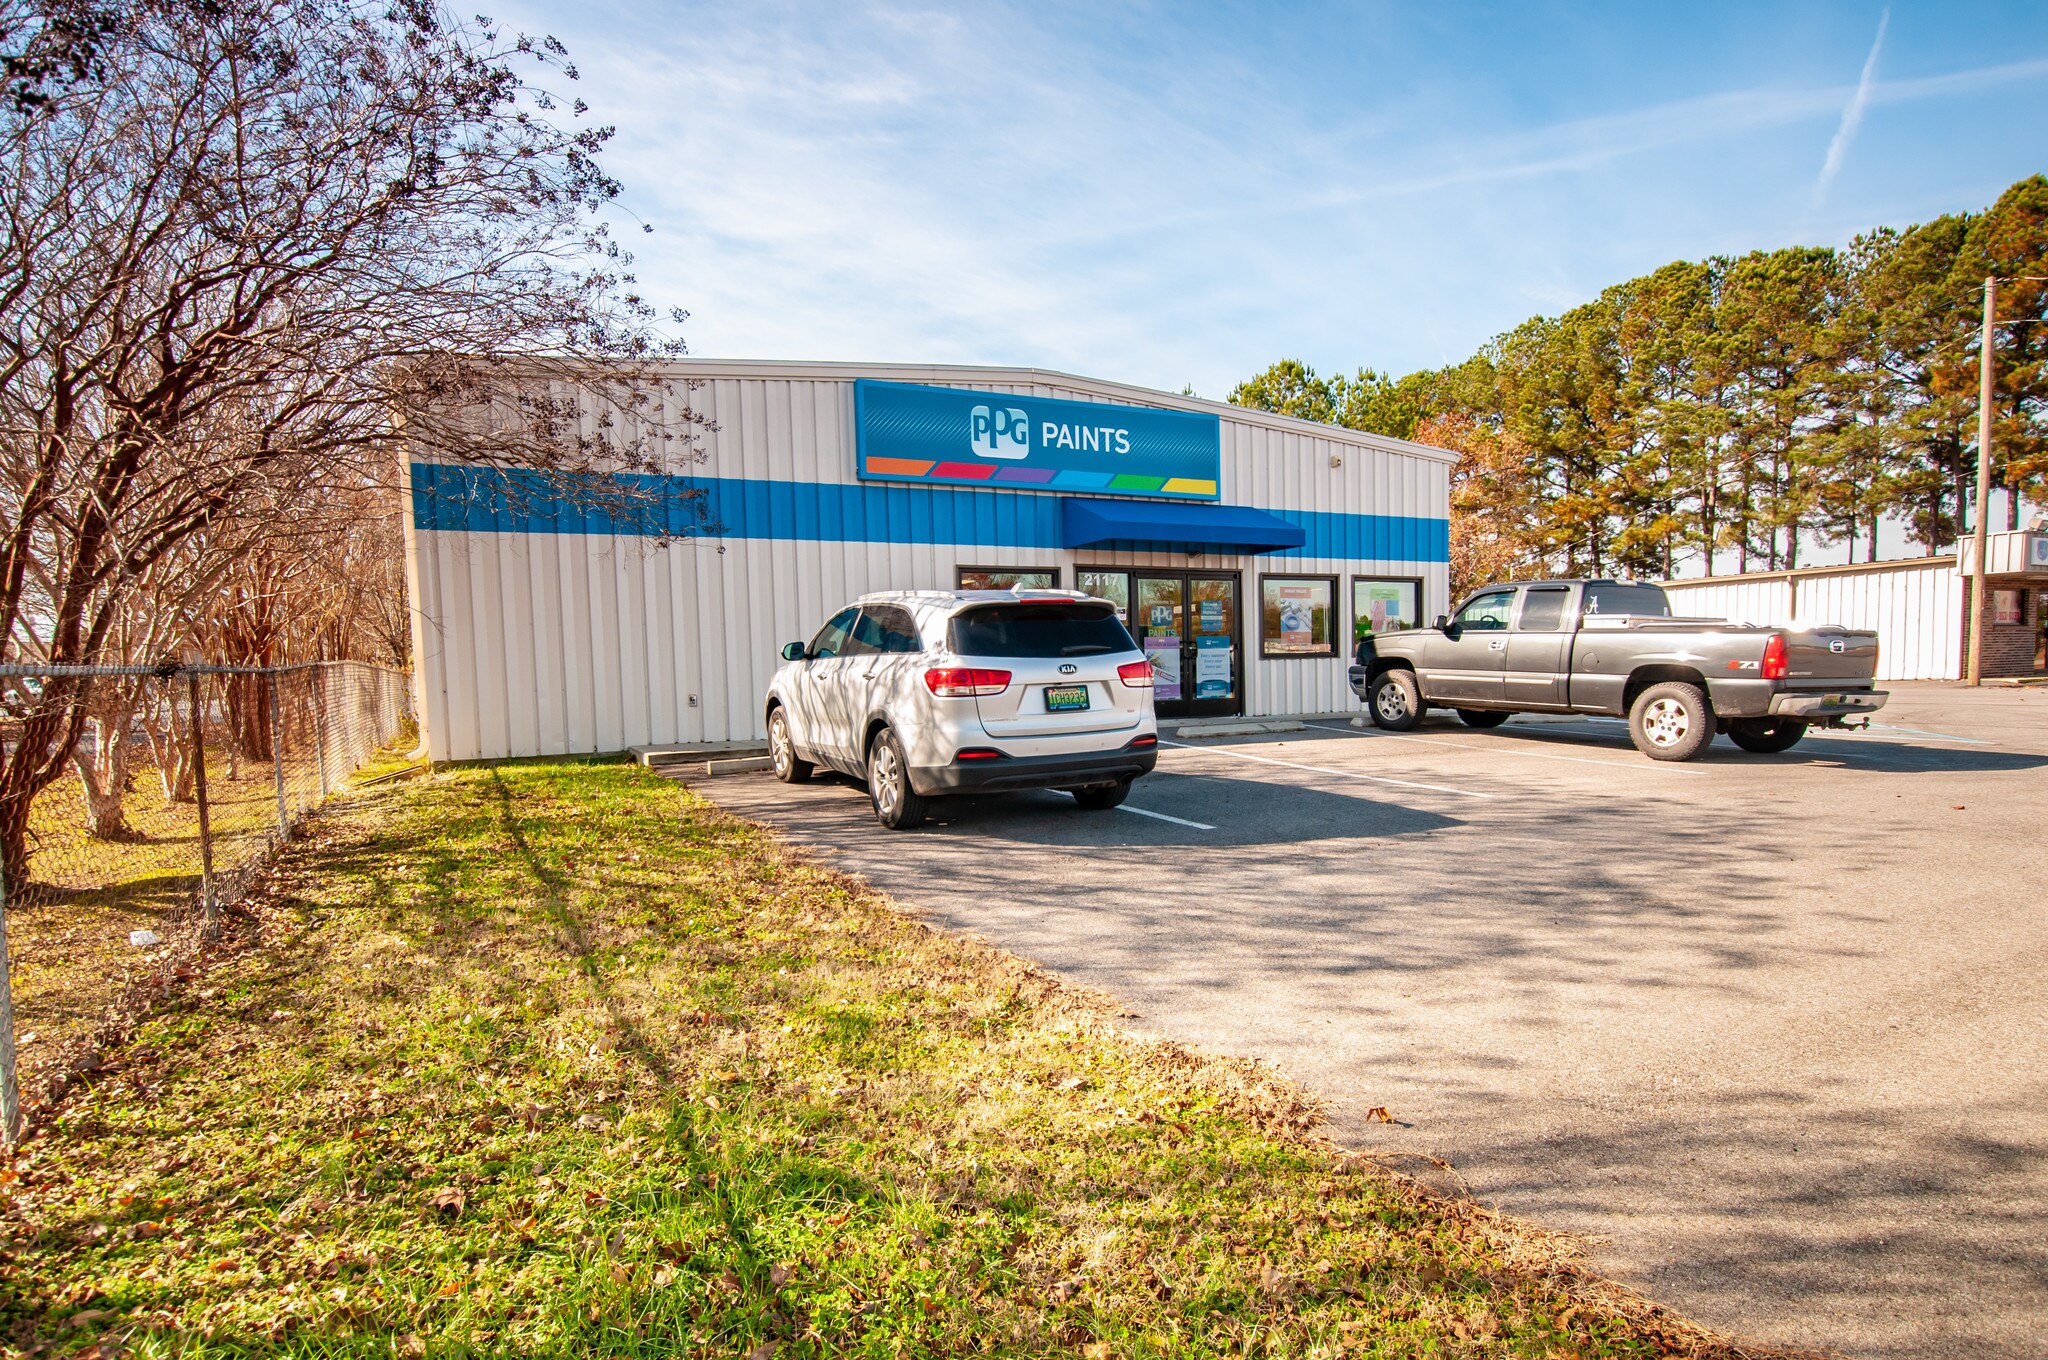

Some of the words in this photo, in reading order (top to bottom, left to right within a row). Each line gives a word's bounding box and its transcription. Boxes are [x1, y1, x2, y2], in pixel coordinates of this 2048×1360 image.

[973, 406, 1027, 449] PPG
[1042, 422, 1130, 454] PAINTS
[1084, 574, 1119, 586] 2117
[1585, 595, 1599, 614] A
[1151, 606, 1173, 623] PPG
[1148, 629, 1177, 637] PAINTS
[1061, 665, 1076, 673] KIA
[1727, 660, 1760, 669] Z71
